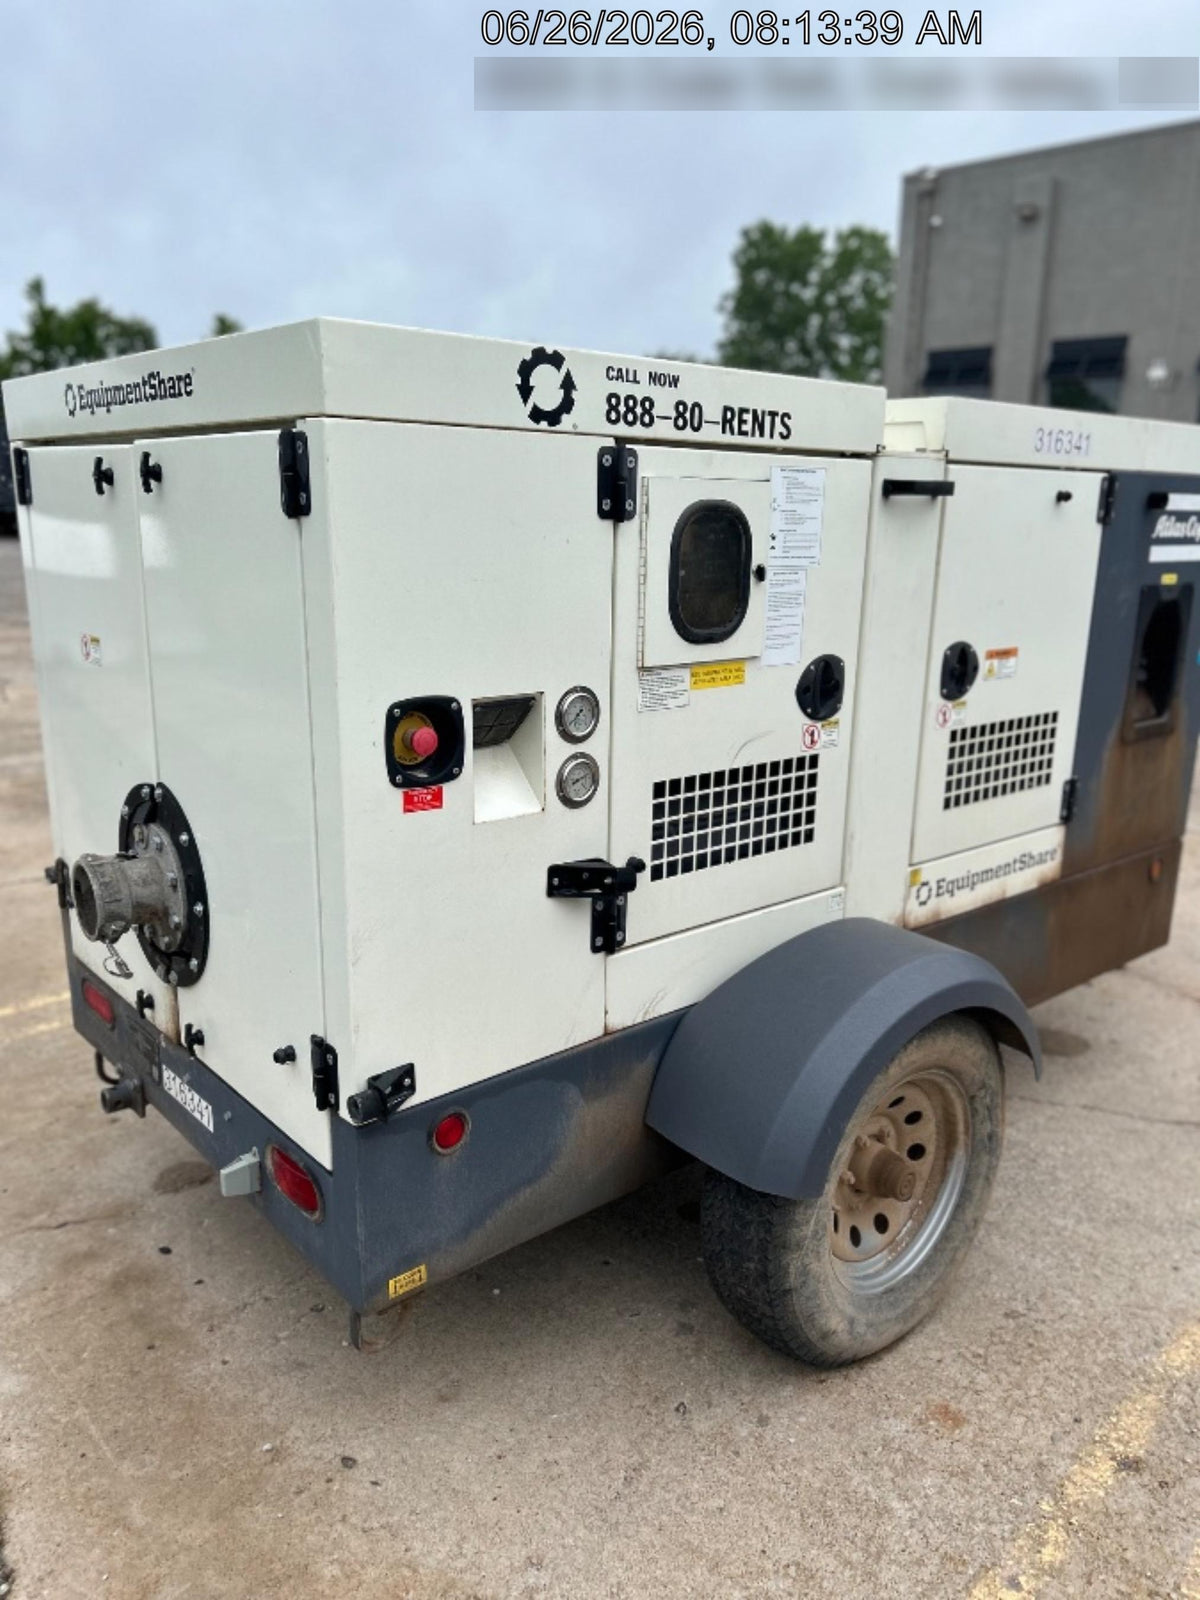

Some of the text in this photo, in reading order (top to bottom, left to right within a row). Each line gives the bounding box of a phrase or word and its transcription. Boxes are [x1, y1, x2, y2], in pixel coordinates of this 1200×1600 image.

[78, 371, 193, 414] EquipmentShare
[605, 365, 680, 389] CALL NOW
[605, 392, 792, 440] 888-80-RENTS
[1034, 427, 1092, 456] 316341
[934, 848, 1057, 897] EquipmentShare
